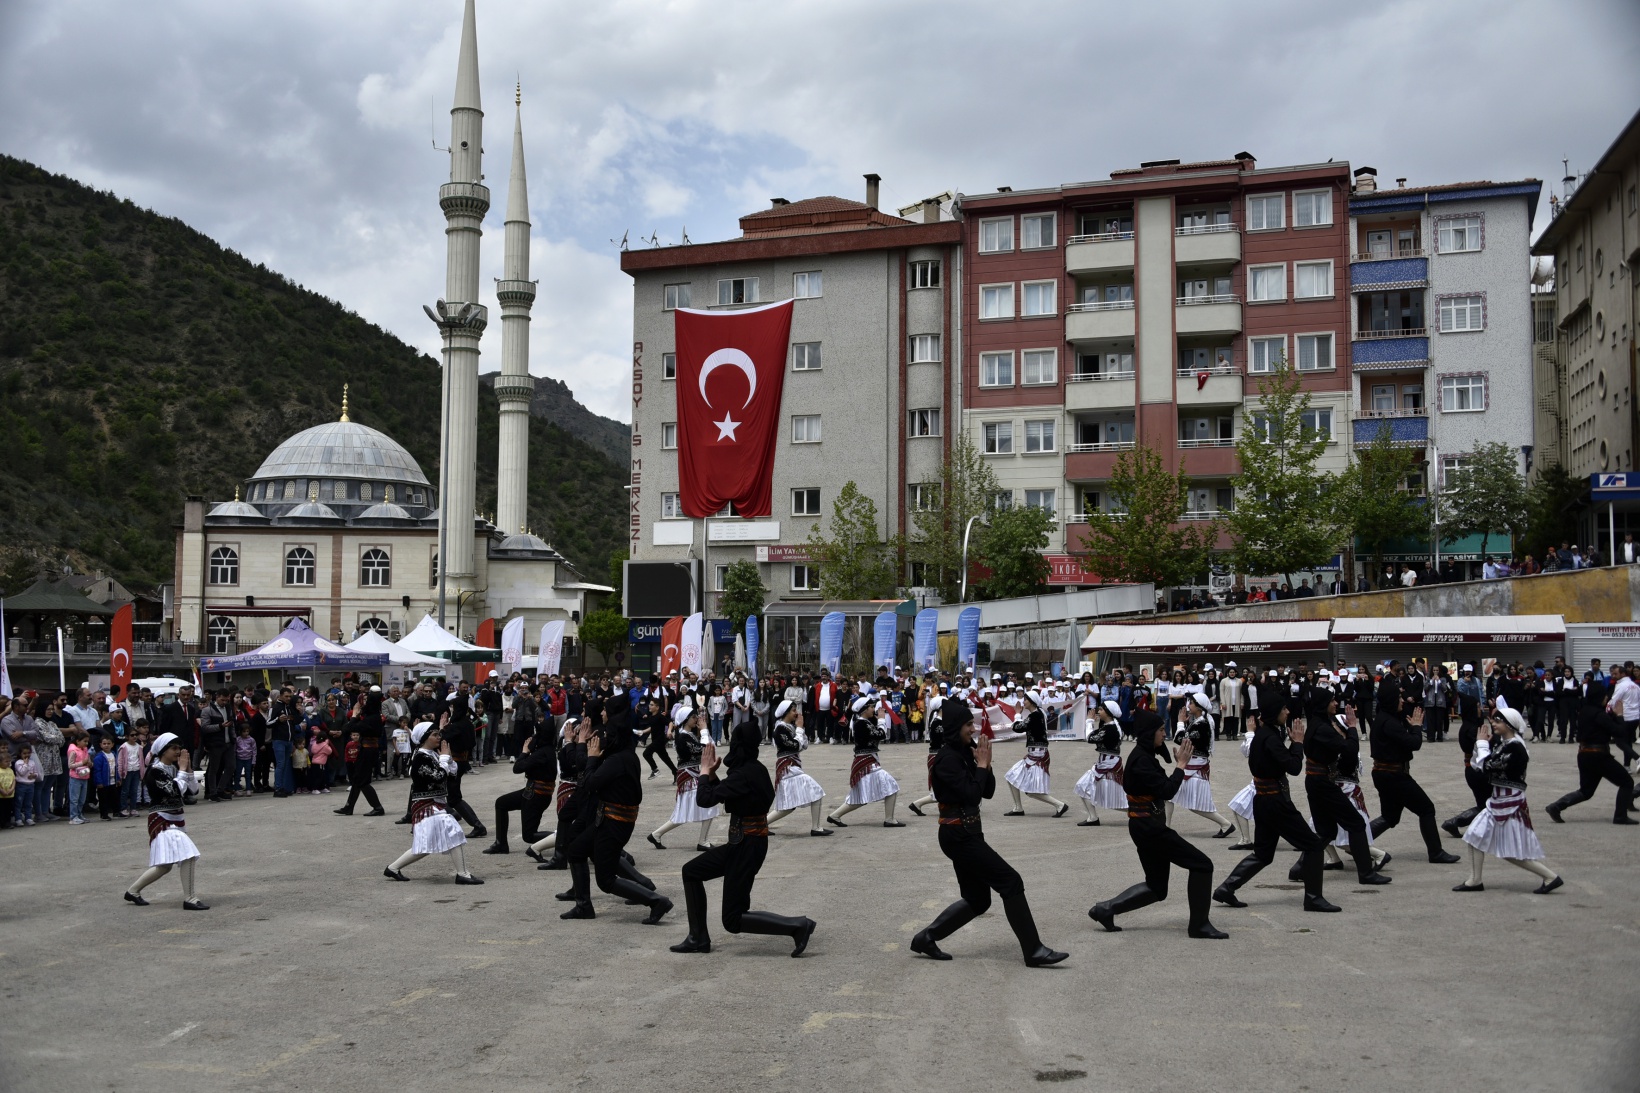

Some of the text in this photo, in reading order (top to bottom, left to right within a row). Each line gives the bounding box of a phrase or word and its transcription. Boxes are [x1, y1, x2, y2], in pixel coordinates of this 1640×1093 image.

[630, 341, 643, 554] AKSOY İŞ MERKEZİ
[769, 547, 783, 555] İLİM
